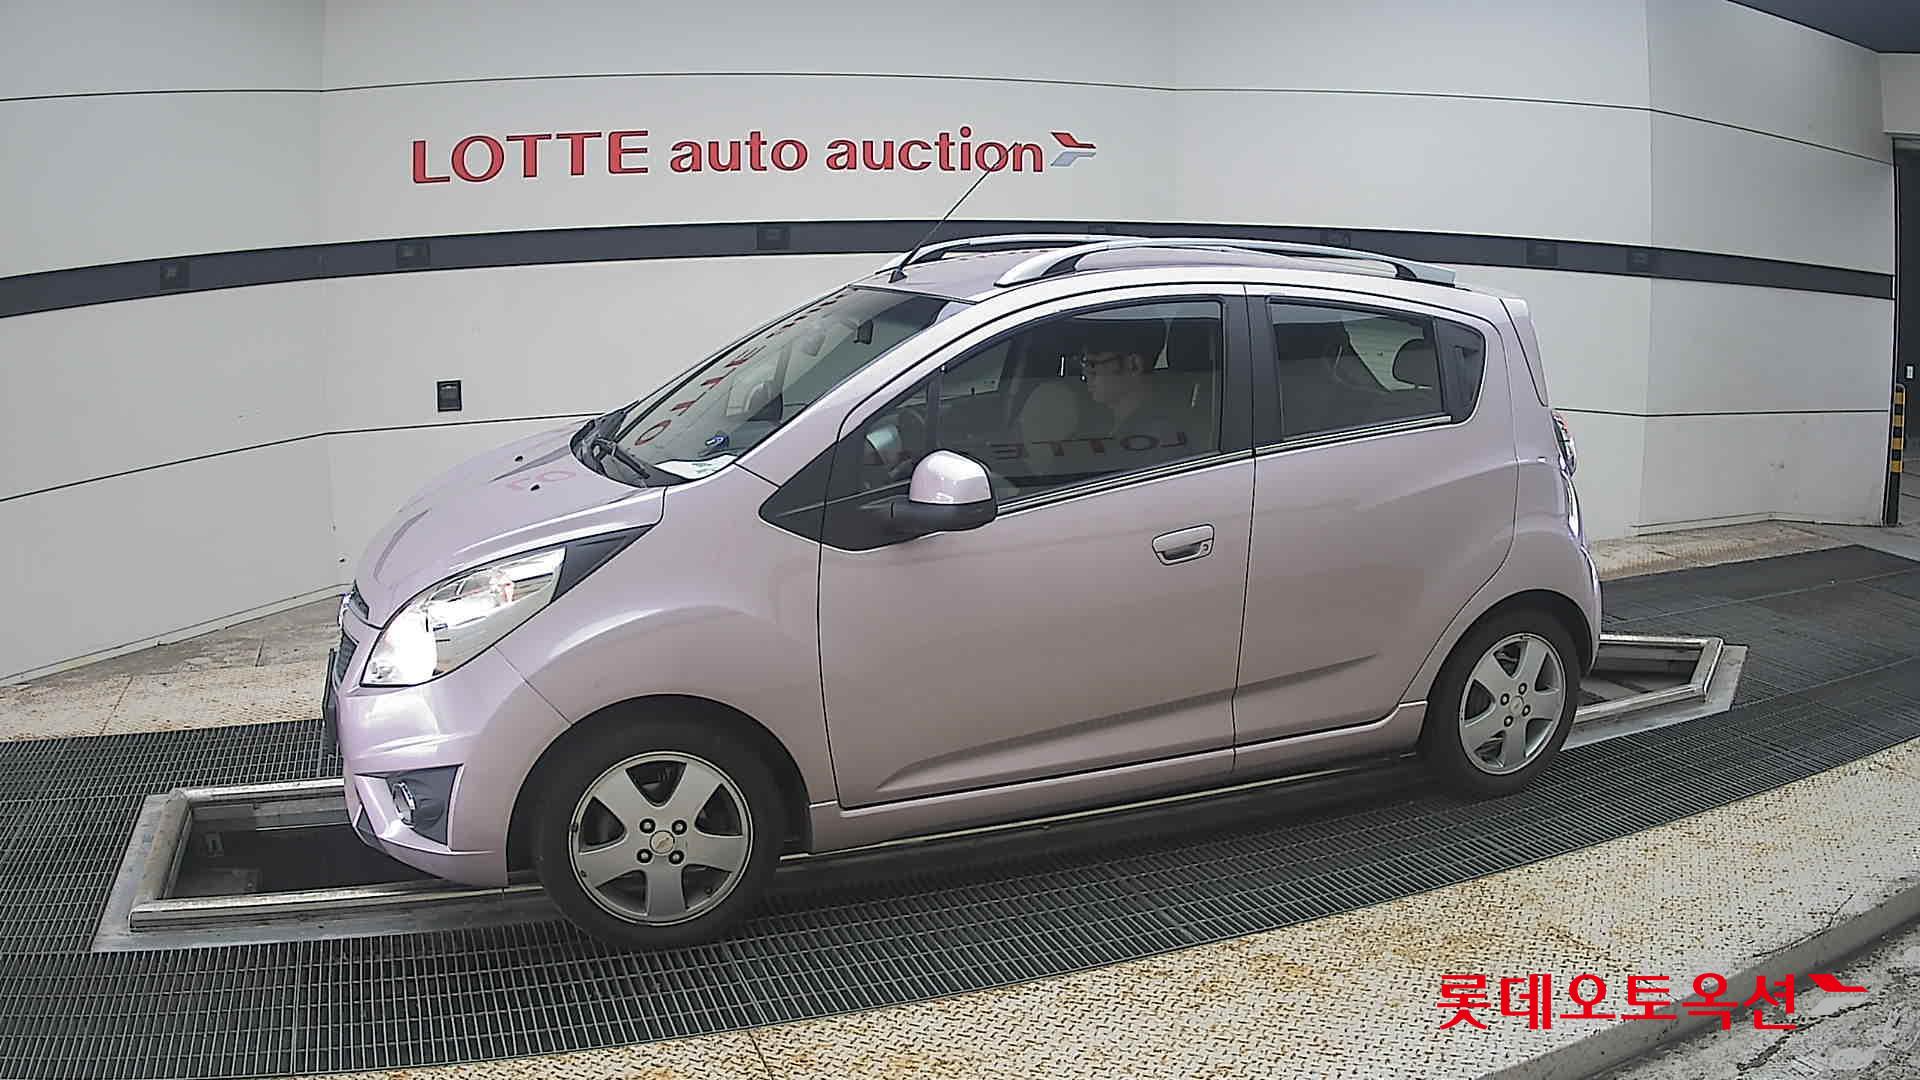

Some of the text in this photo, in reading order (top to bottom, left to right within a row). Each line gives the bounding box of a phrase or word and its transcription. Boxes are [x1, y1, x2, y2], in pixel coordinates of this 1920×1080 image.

[411, 125, 1044, 183] LOTTE auto auction
